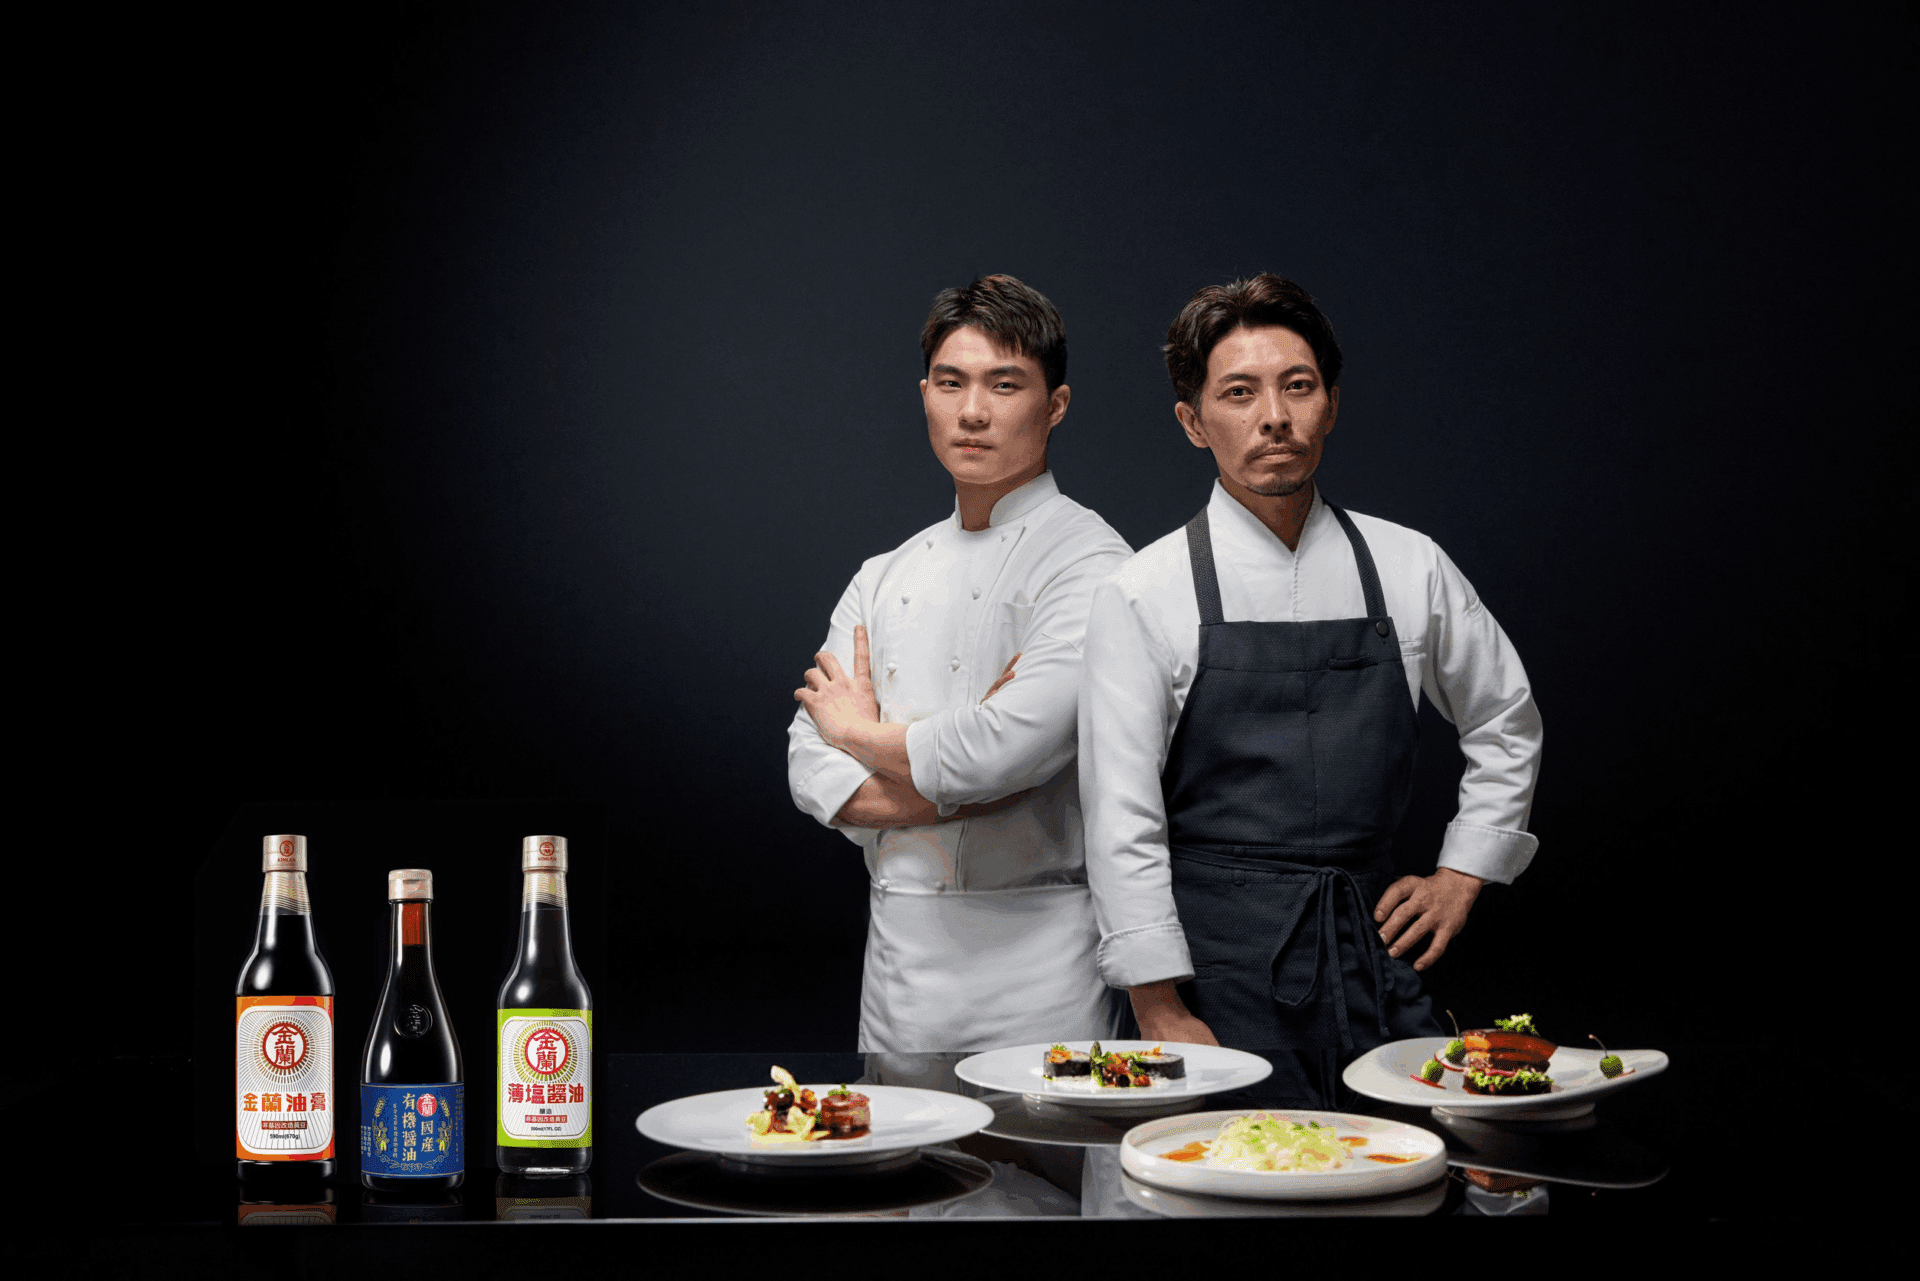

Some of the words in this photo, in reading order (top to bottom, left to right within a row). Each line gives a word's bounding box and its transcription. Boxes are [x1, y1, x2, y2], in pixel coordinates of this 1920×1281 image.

[271, 1025, 299, 1067] 金蘭
[533, 1031, 561, 1070] 金蘭
[243, 1092, 326, 1112] 金蘭油膏
[402, 1092, 417, 1161] 有機醬油
